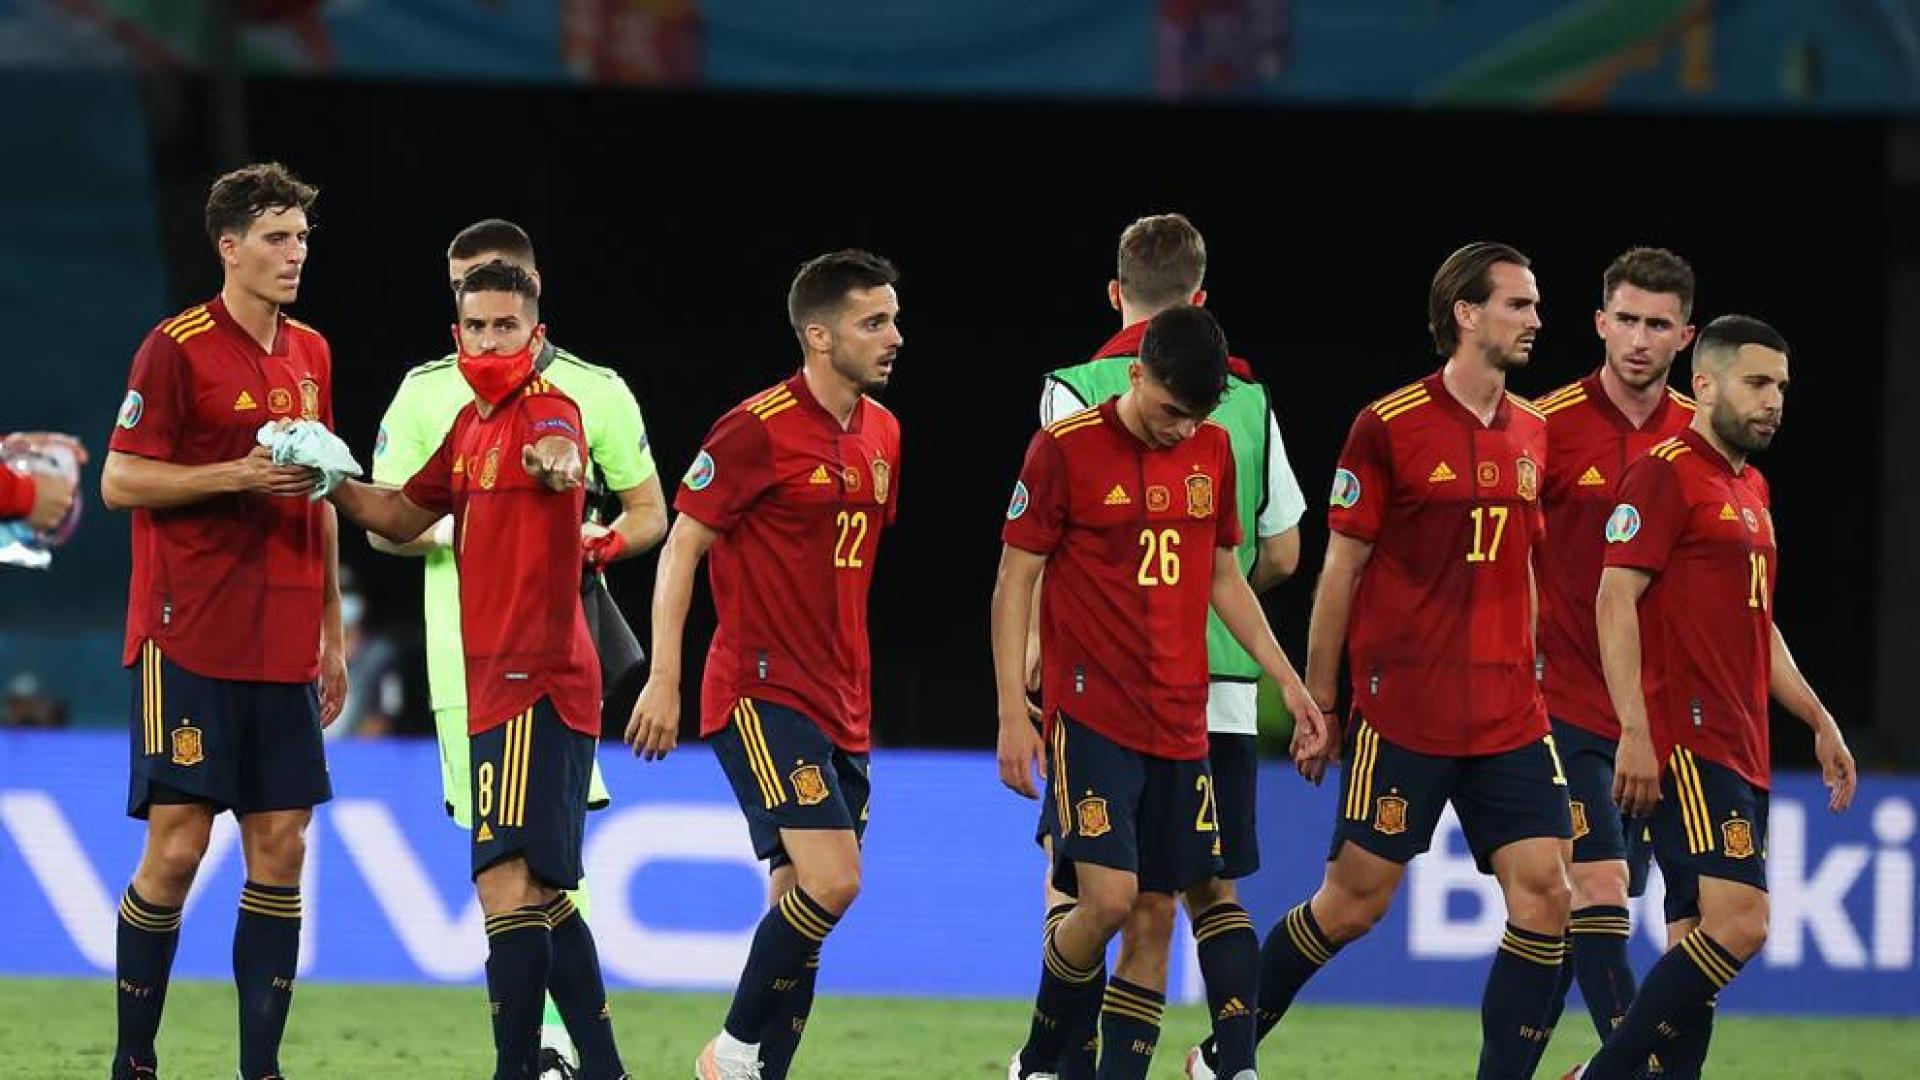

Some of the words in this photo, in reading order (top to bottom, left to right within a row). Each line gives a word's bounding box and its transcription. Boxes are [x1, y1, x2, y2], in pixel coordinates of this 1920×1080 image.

[835, 511, 867, 567] 22
[1138, 528, 1181, 586] 26
[1466, 506, 1509, 561] 17
[479, 761, 494, 816] 8
[1195, 775, 1219, 832] 2
[1406, 796, 1917, 970] Bki
